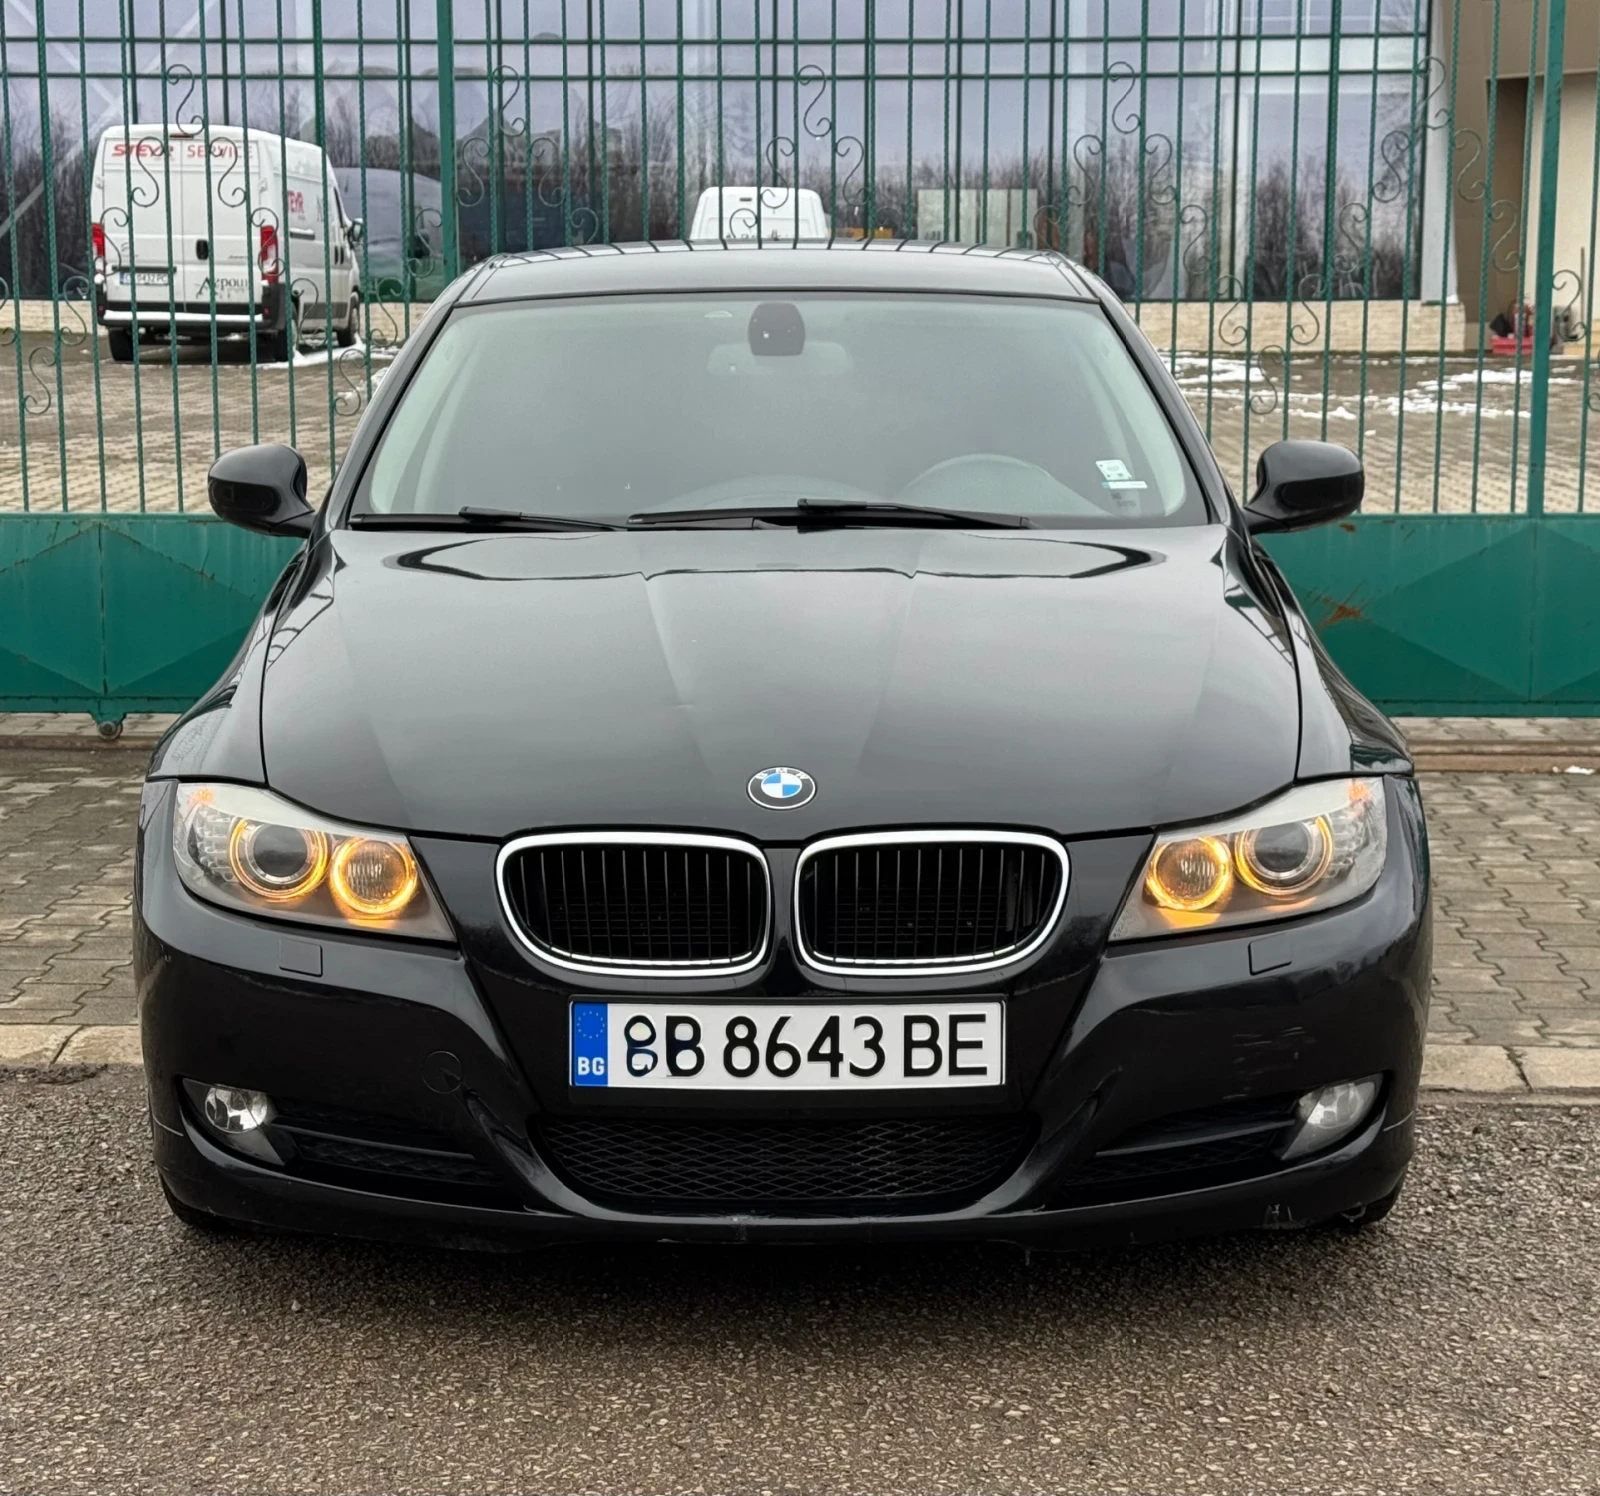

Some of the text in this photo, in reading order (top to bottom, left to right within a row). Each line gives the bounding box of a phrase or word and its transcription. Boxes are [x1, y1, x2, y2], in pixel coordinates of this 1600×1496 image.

[577, 1056, 605, 1076] BG
[723, 1015, 885, 1078] 8643
[903, 1012, 988, 1078] BE
